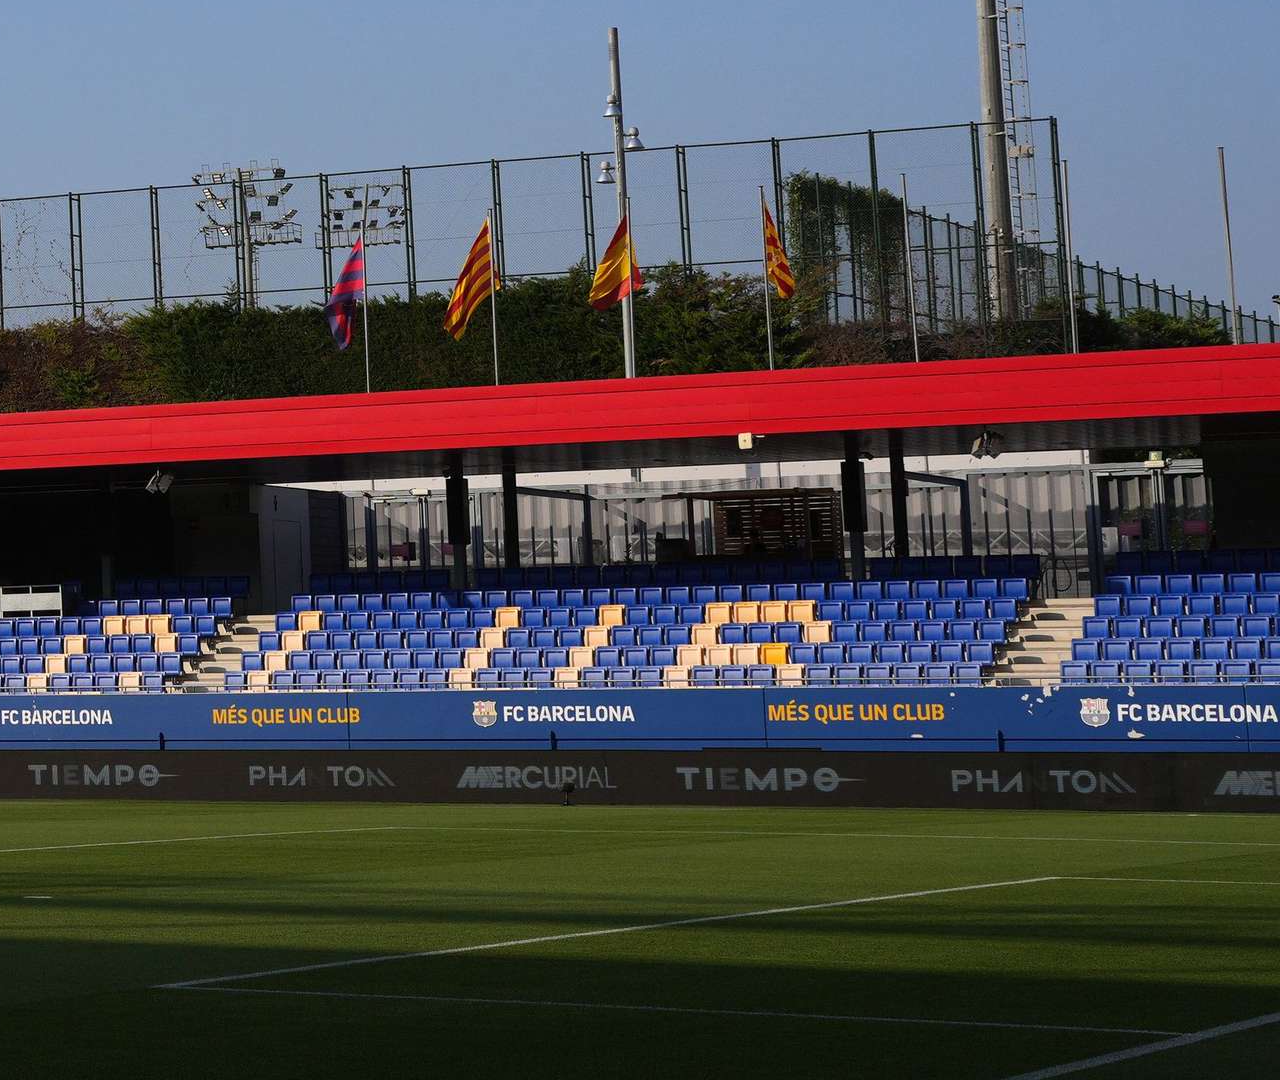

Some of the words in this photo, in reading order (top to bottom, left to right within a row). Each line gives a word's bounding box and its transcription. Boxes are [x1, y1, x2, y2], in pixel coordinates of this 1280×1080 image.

[1, 709, 19, 725] FC
[21, 709, 113, 725] BARCELONA
[212, 705, 248, 724] MÉS
[251, 708, 285, 727] QUE
[289, 708, 313, 724] UN
[317, 708, 360, 724] CLUB
[503, 705, 526, 722] FC
[528, 705, 635, 722] BARCELONA
[768, 699, 809, 722] MÉS
[814, 703, 854, 725] QUE
[859, 703, 888, 722] UN
[893, 703, 945, 722] CLUB
[1117, 703, 1142, 723] FC
[1147, 703, 1279, 723] BARCELONA
[28, 764, 181, 787] TIEMPO
[248, 766, 398, 787] PHATOM
[456, 766, 619, 789] MERCURIAL
[676, 767, 865, 793] TIEMPO
[1213, 770, 1280, 796] ME
